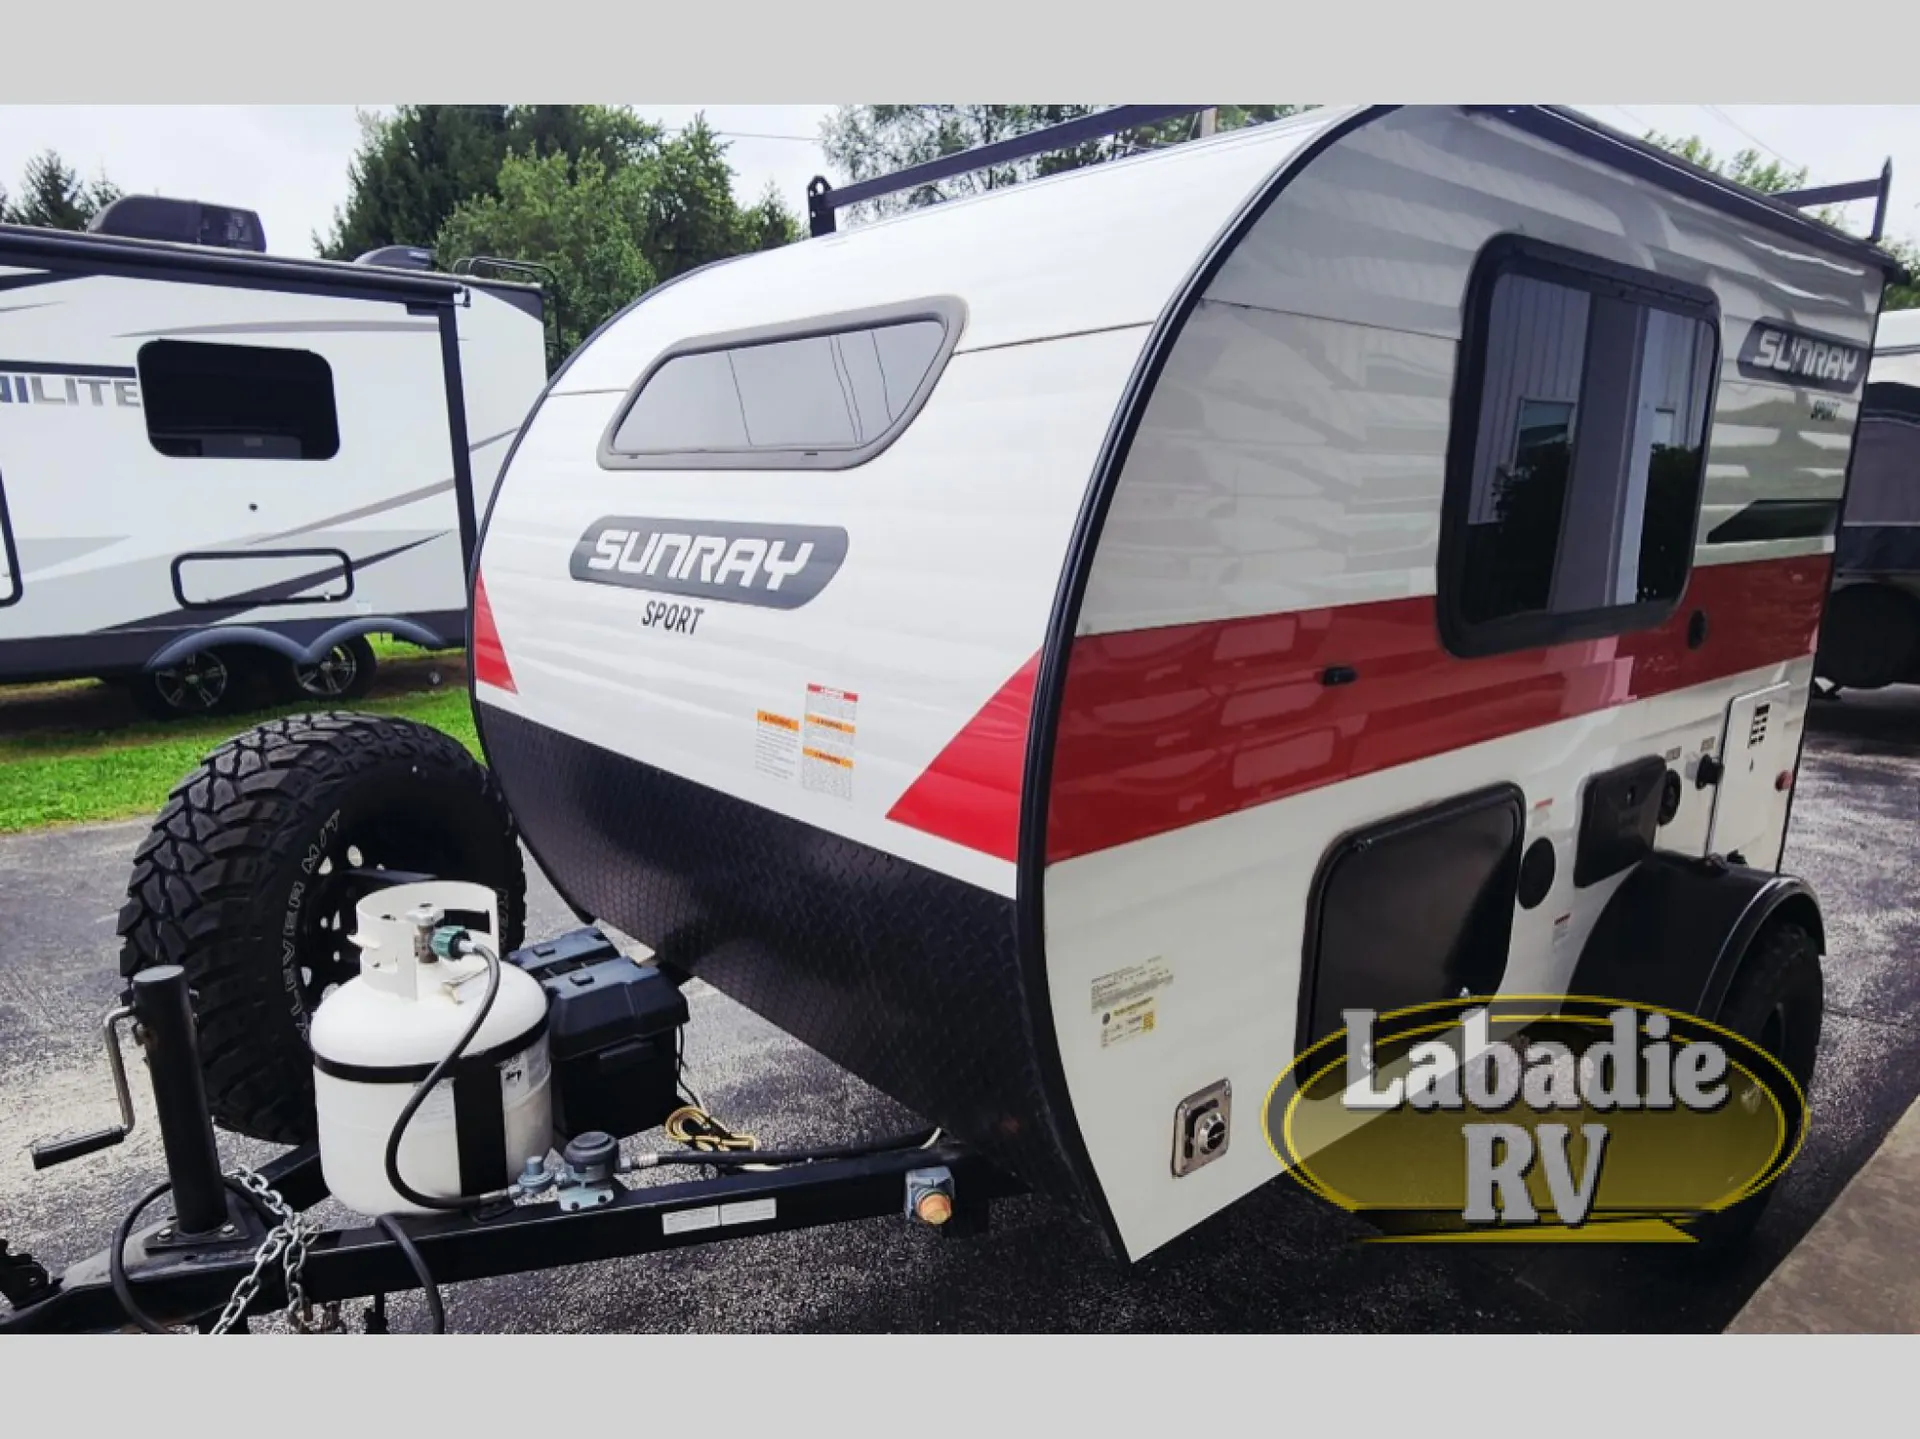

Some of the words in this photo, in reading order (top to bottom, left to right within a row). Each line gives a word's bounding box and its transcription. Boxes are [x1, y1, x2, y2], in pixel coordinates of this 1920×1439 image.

[1752, 330, 1859, 382] SUNRAY
[588, 529, 815, 591] SUNRAY
[641, 600, 705, 635] SPORT
